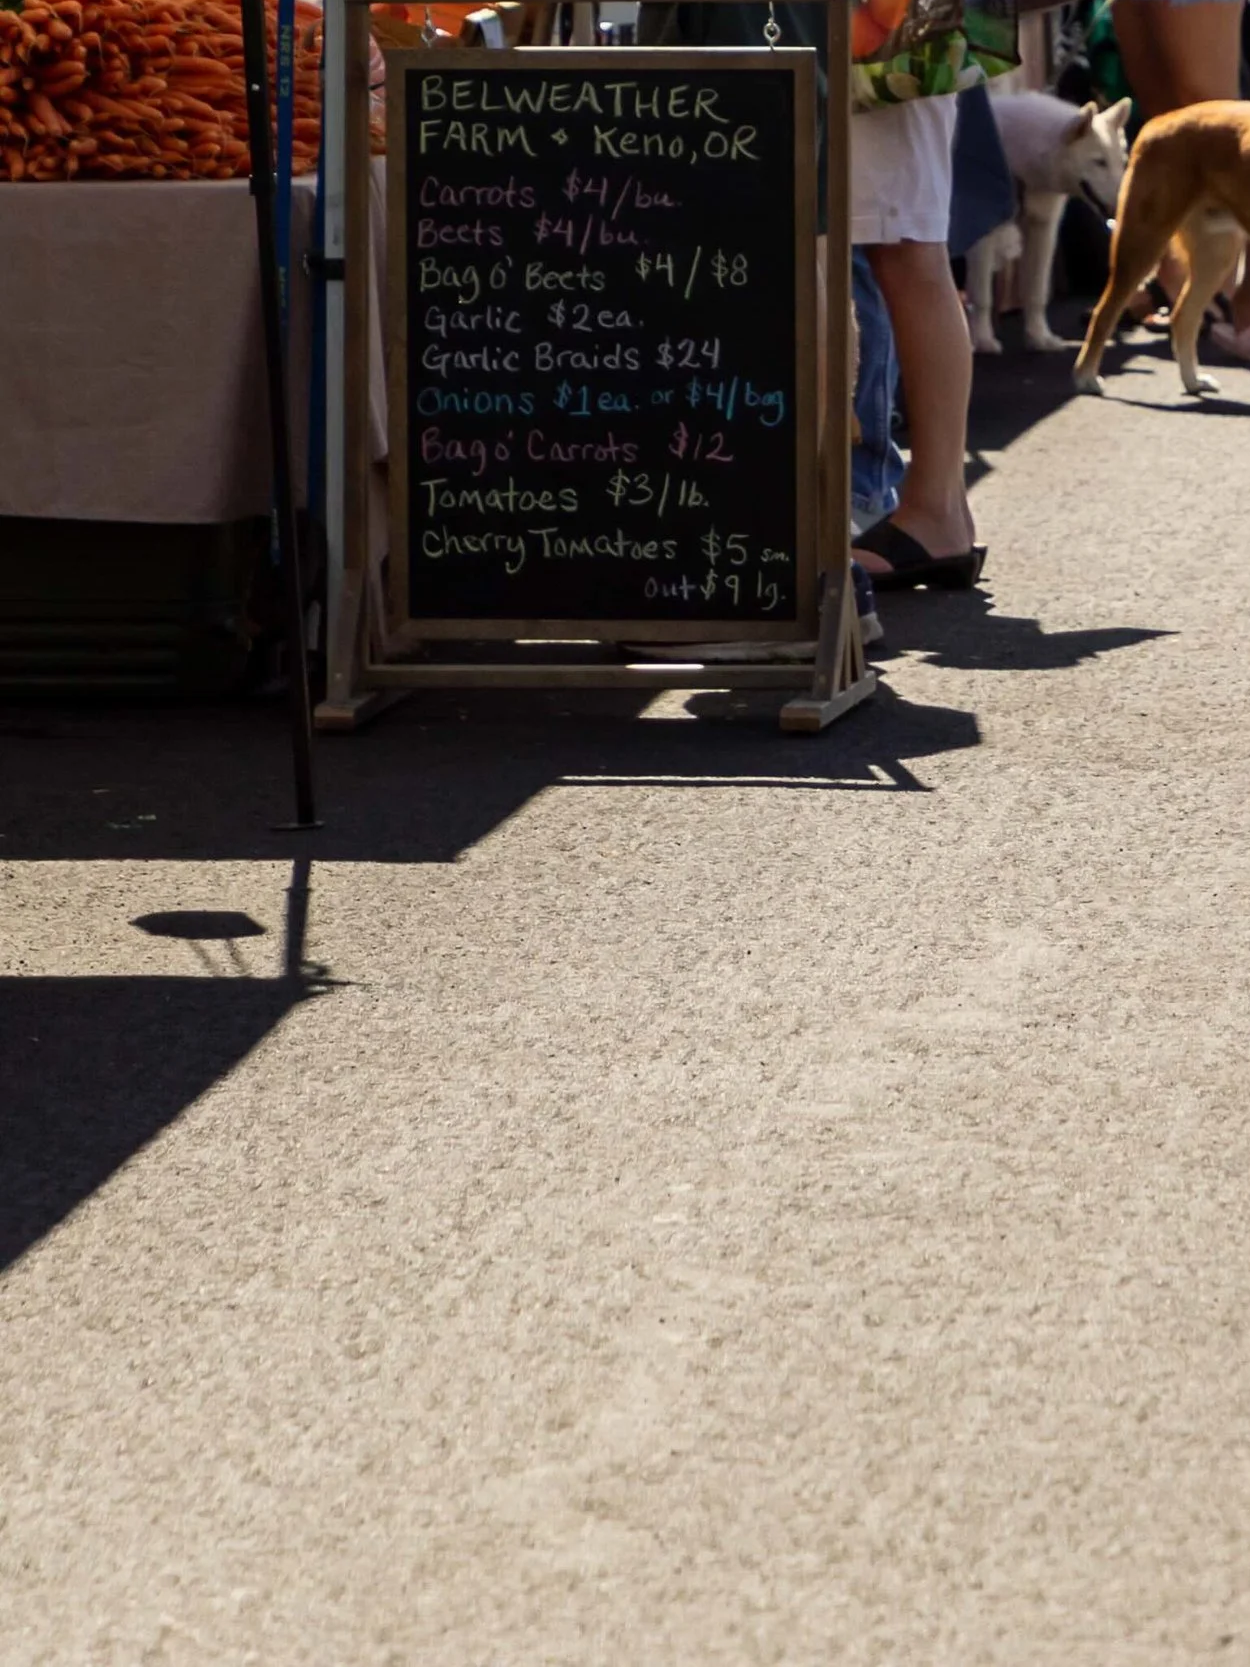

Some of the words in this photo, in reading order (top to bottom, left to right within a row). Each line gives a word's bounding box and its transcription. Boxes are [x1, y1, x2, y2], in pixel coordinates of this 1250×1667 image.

[279, 24, 292, 67] NRS
[277, 74, 290, 98] 12
[420, 74, 730, 124] BELWEATHER
[419, 119, 538, 158] FARM
[420, 174, 536, 209] Carrots
[416, 217, 505, 250] Beets
[419, 256, 480, 306] Bag
[524, 261, 606, 291] Beets
[424, 302, 523, 337] Garlic
[421, 342, 521, 379] Garlic
[534, 341, 641, 371] Braids
[655, 335, 722, 370] $24
[415, 384, 535, 417] Onions
[651, 388, 675, 406] or
[421, 426, 488, 477] Bag
[526, 427, 640, 463] Carrots
[667, 420, 735, 462] $12
[420, 475, 579, 518] Tomatoes
[421, 527, 526, 575] Cherry
[529, 526, 678, 560] Tomatoes
[700, 523, 750, 567] $5
[699, 567, 740, 606] $9
